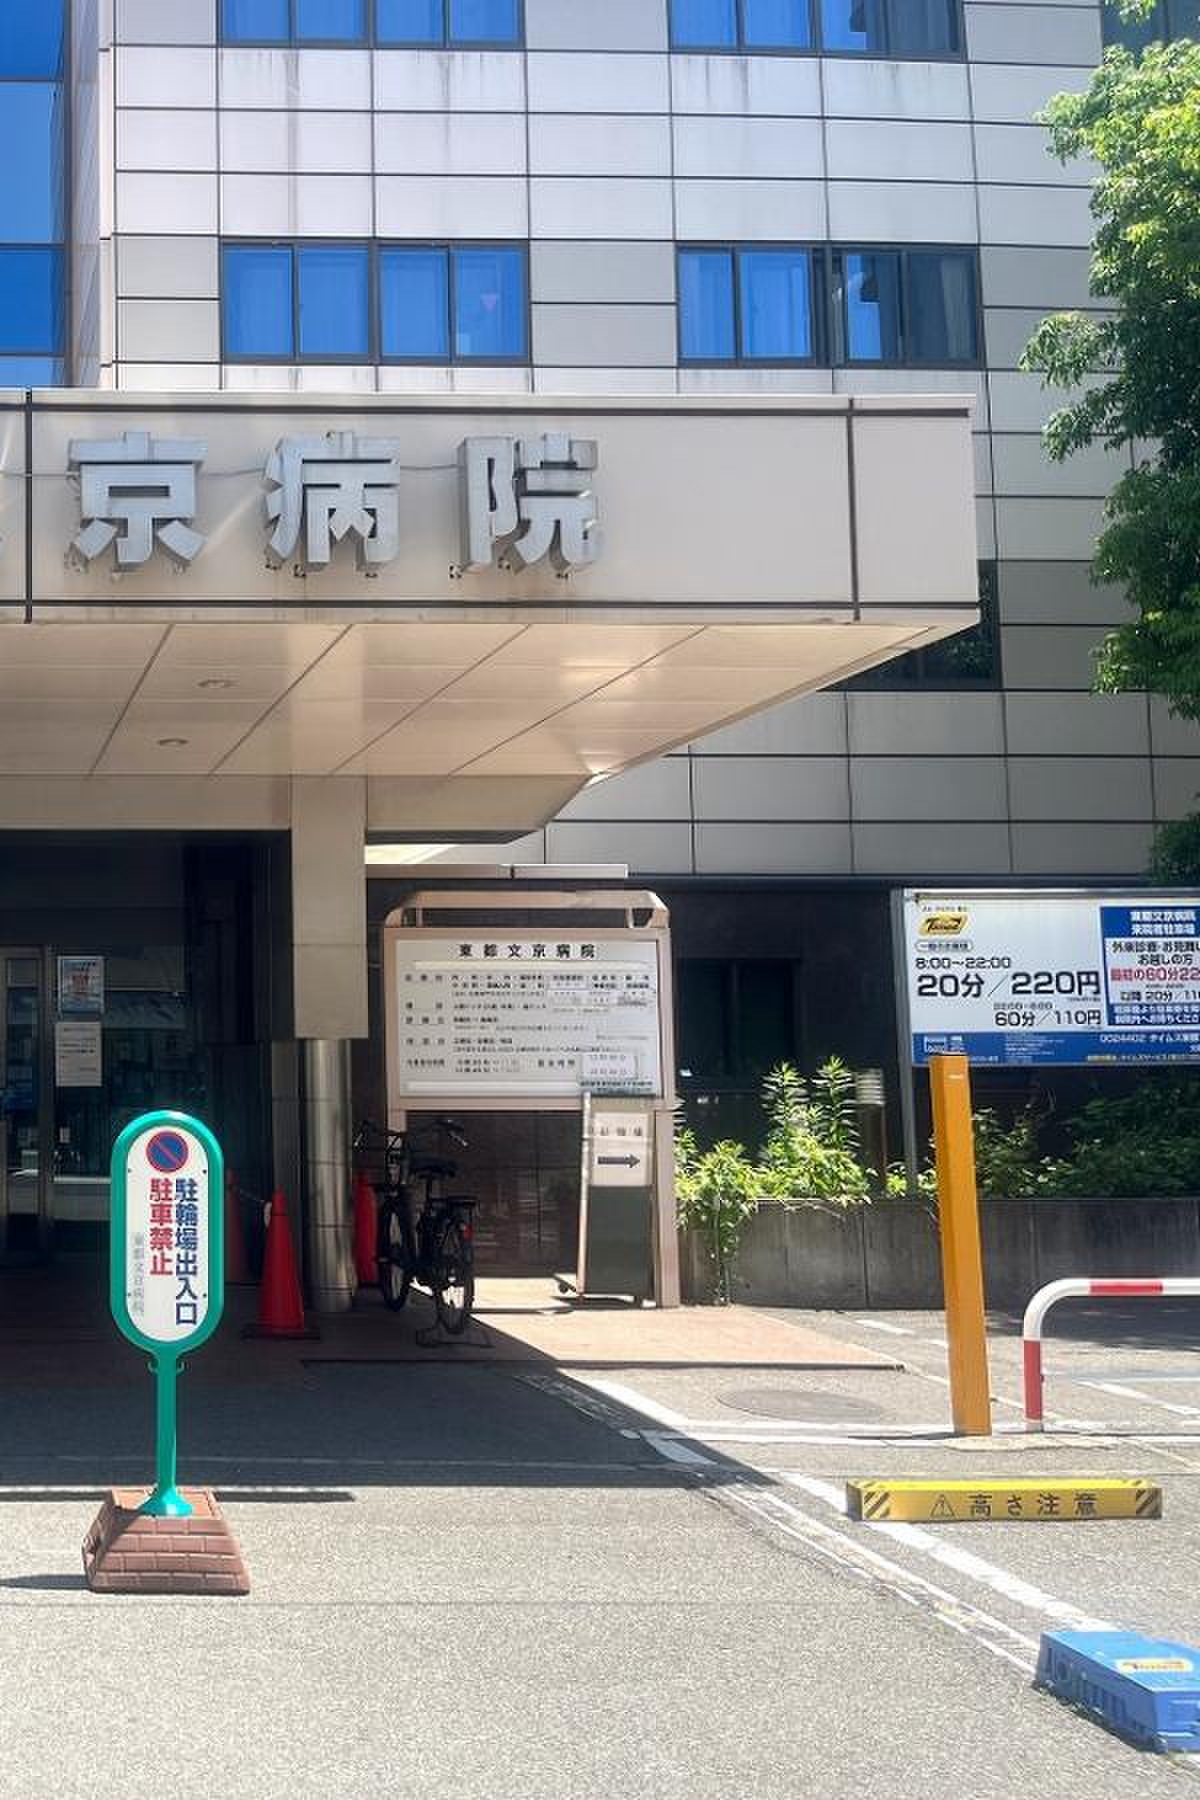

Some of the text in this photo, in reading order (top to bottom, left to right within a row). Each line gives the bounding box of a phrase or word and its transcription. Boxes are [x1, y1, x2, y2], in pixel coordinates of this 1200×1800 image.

[458, 943, 598, 958] 東都文京病院
[149, 1177, 173, 1276] 駐車禁止
[175, 1177, 198, 1325] 駐輪場出入口
[968, 1492, 1099, 1517] 高さ注意
